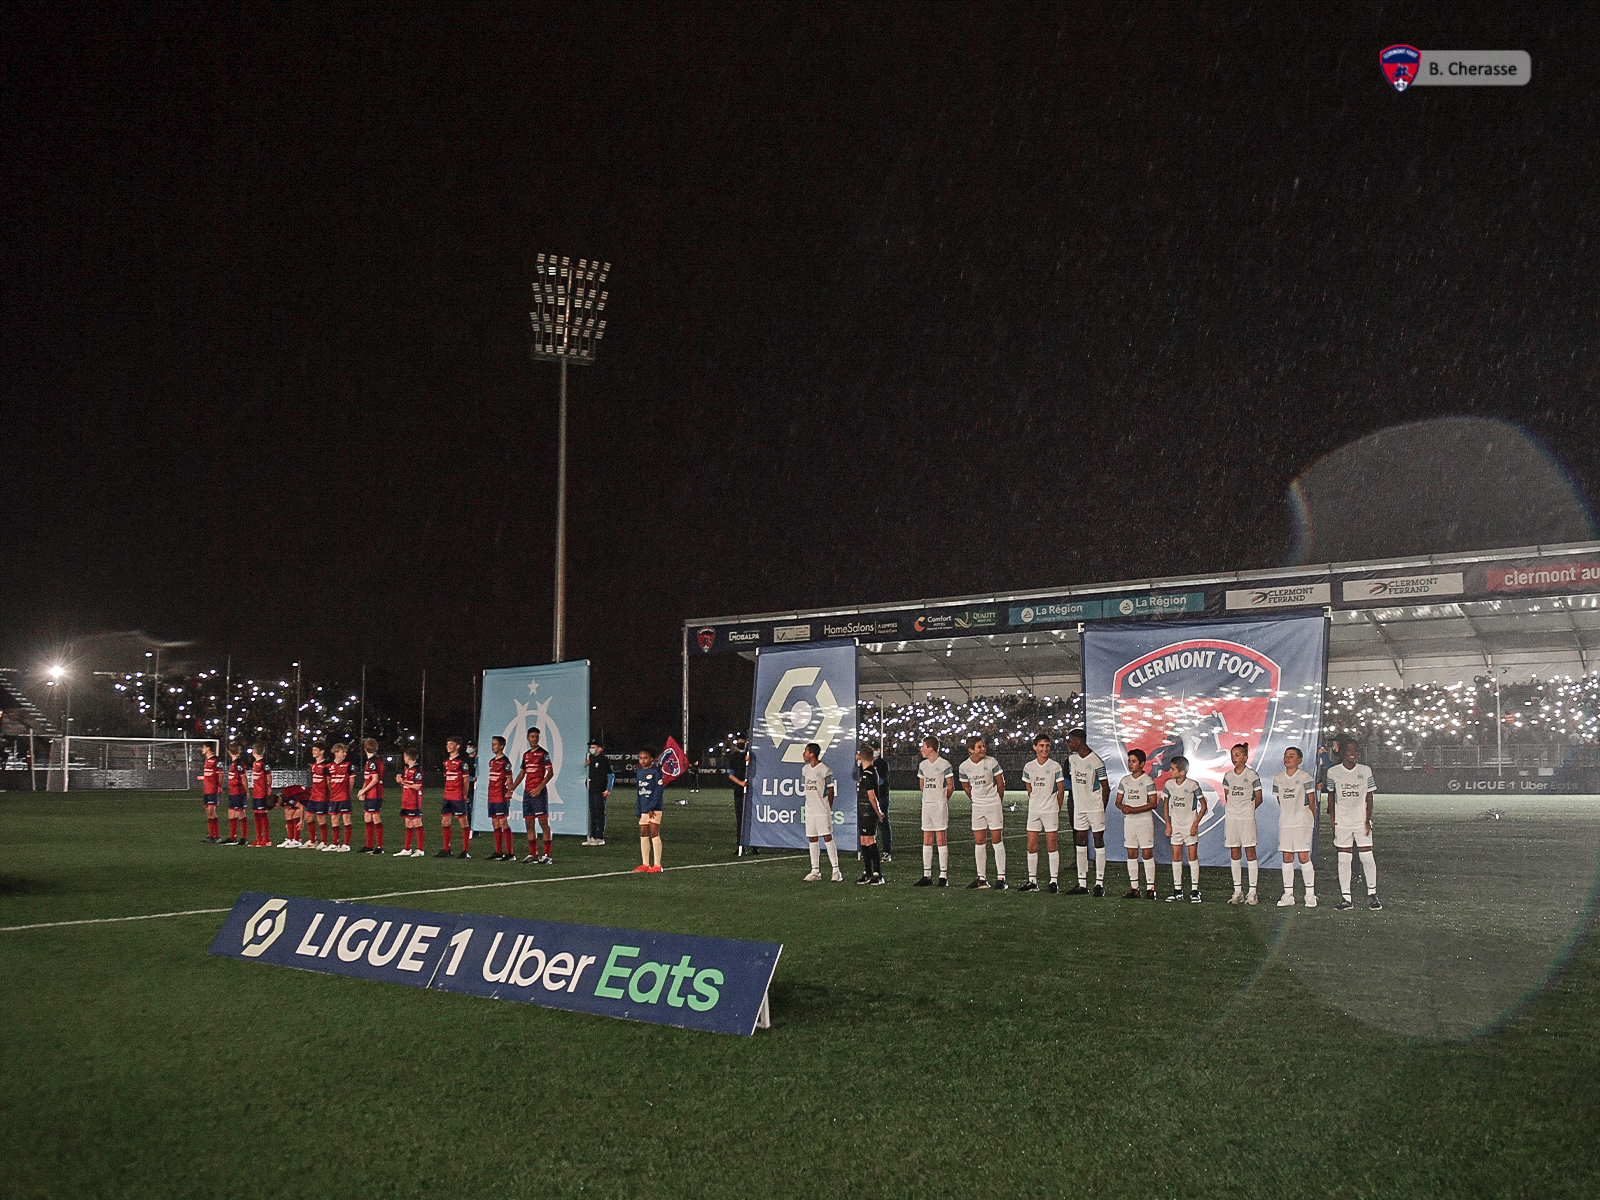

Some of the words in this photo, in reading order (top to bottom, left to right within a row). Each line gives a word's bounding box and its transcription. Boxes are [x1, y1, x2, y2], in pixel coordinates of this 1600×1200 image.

[1504, 566, 1576, 586] clermont
[1388, 578, 1439, 587] CLERMONT
[1268, 587, 1314, 597] CLERMONT
[1388, 585, 1430, 595] FERRAND
[1136, 598, 1148, 608] La
[1149, 595, 1187, 608] Région
[1268, 595, 1306, 604] FERRAND
[1036, 606, 1047, 616] La
[1049, 603, 1083, 615] Région
[927, 615, 952, 623] Comfort
[972, 612, 997, 620] QUALITY
[823, 622, 875, 635] HomeSalons
[1127, 650, 1217, 688] CLERMONT
[1217, 652, 1266, 684] FOOT
[761, 778, 806, 797] LIGU
[1341, 782, 1360, 790] Uber
[1464, 780, 1506, 790] LIGUE
[1508, 781, 1516, 790] 1
[1520, 780, 1549, 790] Uber
[1550, 781, 1579, 790] Eats
[1341, 790, 1360, 798] Eats
[755, 804, 797, 824] Uber
[295, 912, 441, 971] LIGUE
[444, 927, 474, 976] 1
[481, 931, 596, 994] Uber
[594, 944, 724, 1012] Eats
